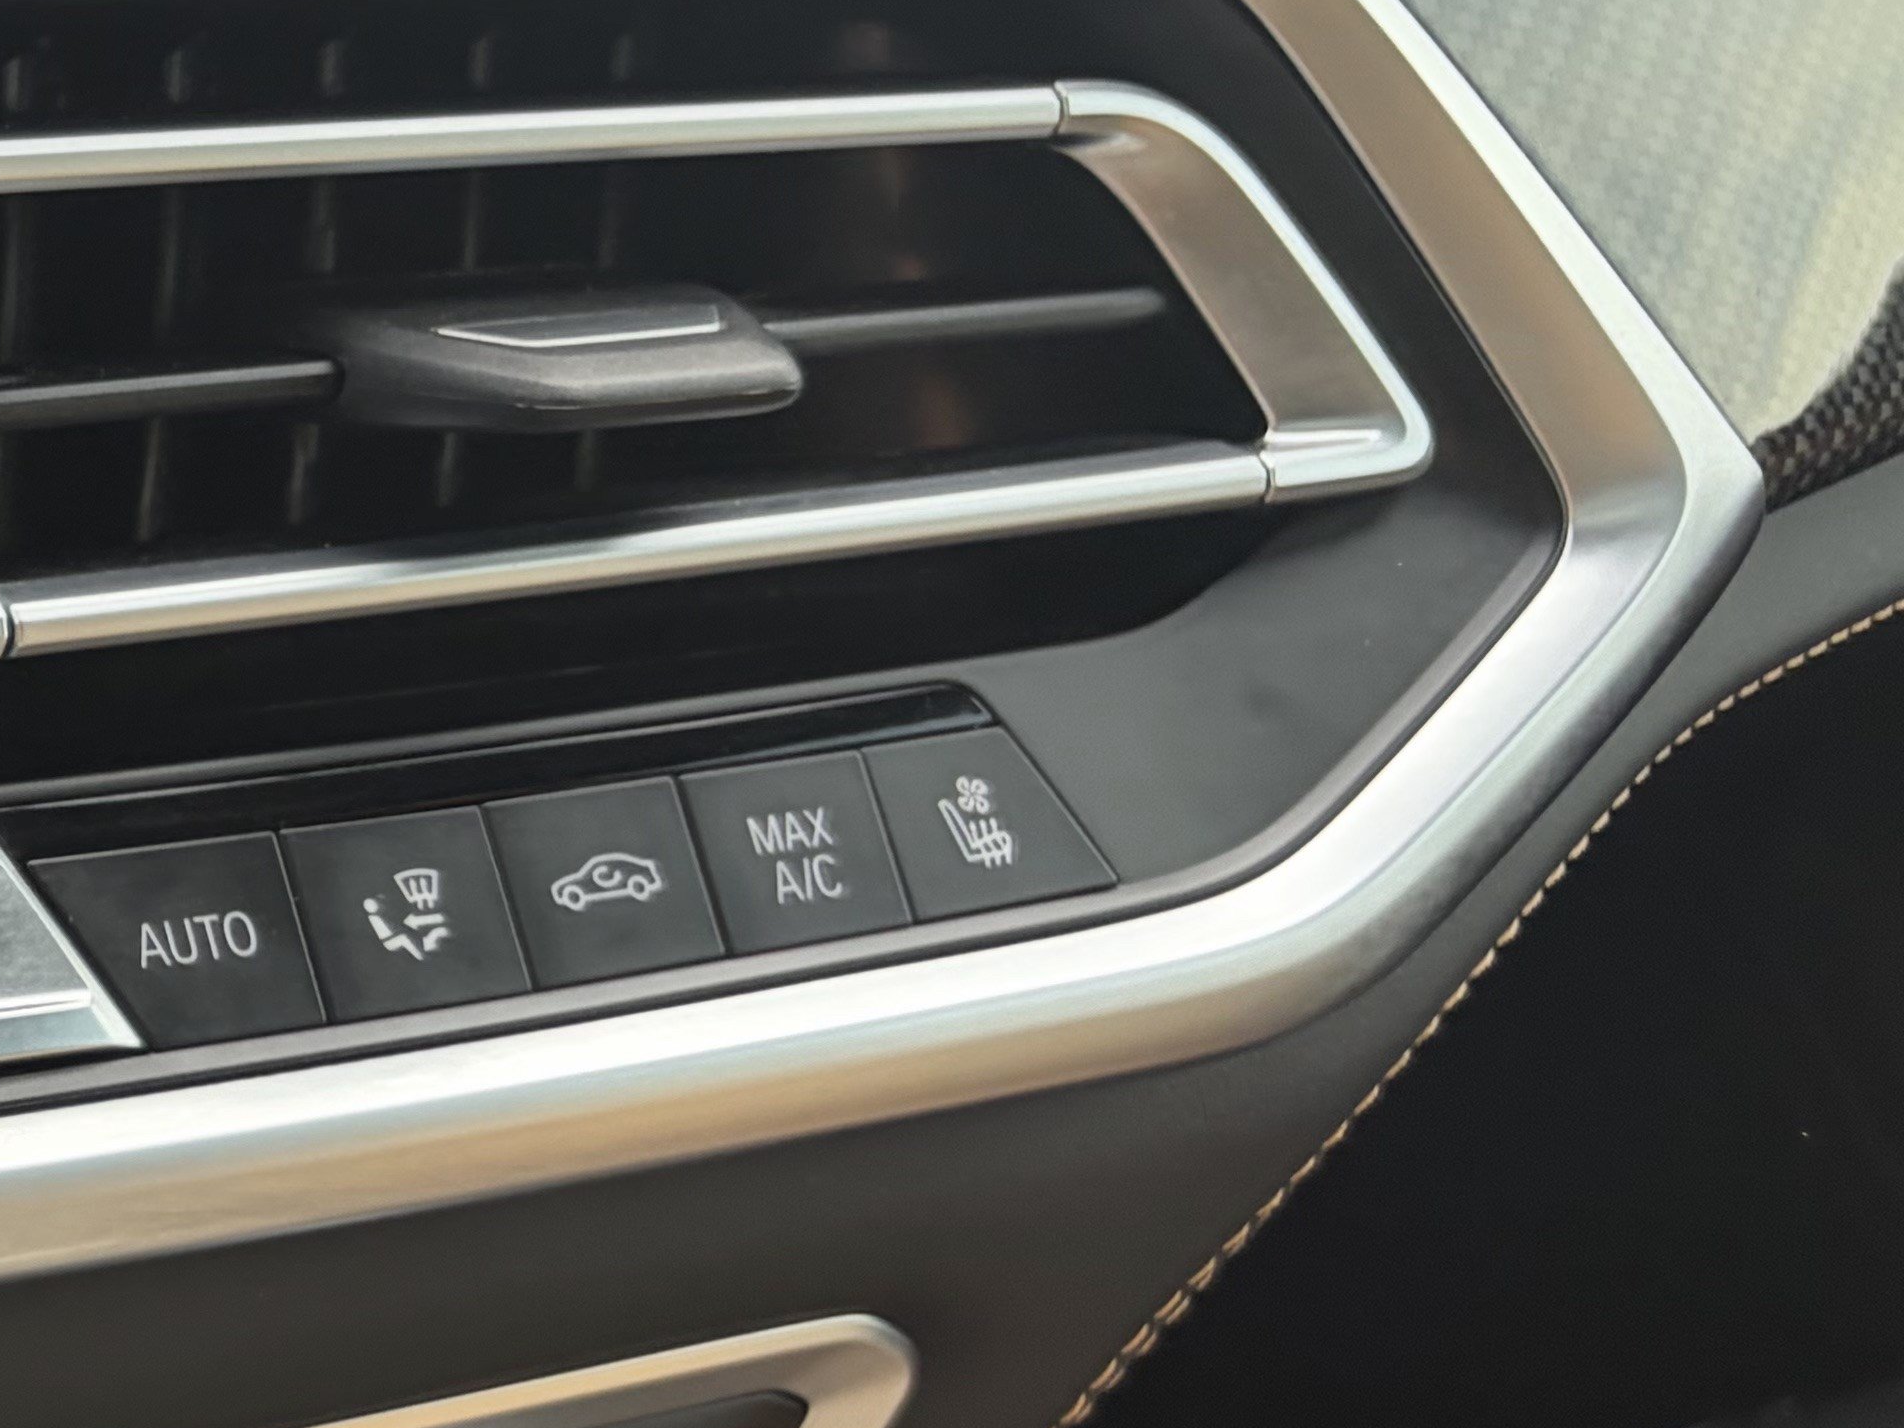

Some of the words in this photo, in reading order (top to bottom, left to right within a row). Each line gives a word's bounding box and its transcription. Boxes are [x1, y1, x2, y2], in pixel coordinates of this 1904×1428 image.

[746, 807, 835, 856] MAX
[774, 851, 845, 903] A/C
[140, 910, 258, 969] AUTO
